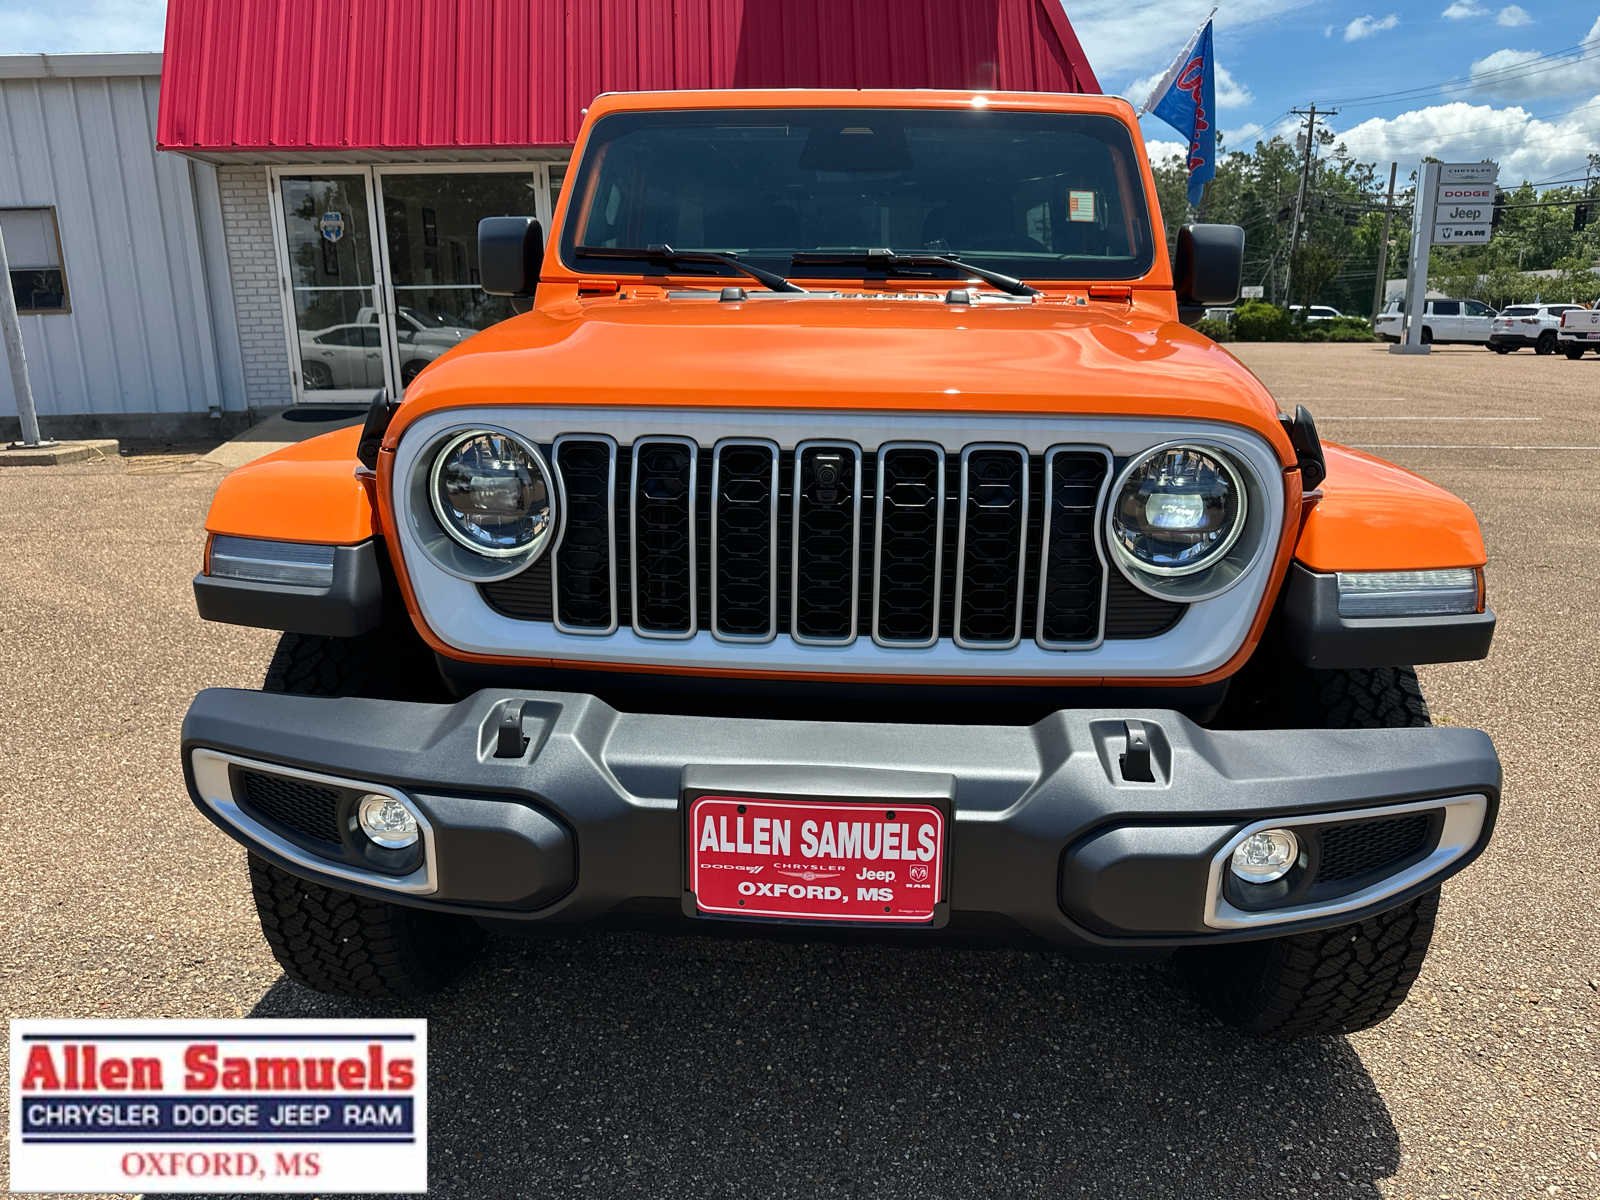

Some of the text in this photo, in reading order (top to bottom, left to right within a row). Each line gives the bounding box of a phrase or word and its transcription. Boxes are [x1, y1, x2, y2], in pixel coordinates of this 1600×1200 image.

[1444, 190, 1490, 198] DODGE
[1449, 207, 1481, 220] Jeep
[699, 815, 936, 862] ALLEN SAMUELS
[700, 863, 754, 871] DODGE
[773, 862, 846, 872] CHRYSLER
[855, 867, 895, 883] Jeep
[738, 881, 894, 903] OXFORD, MS
